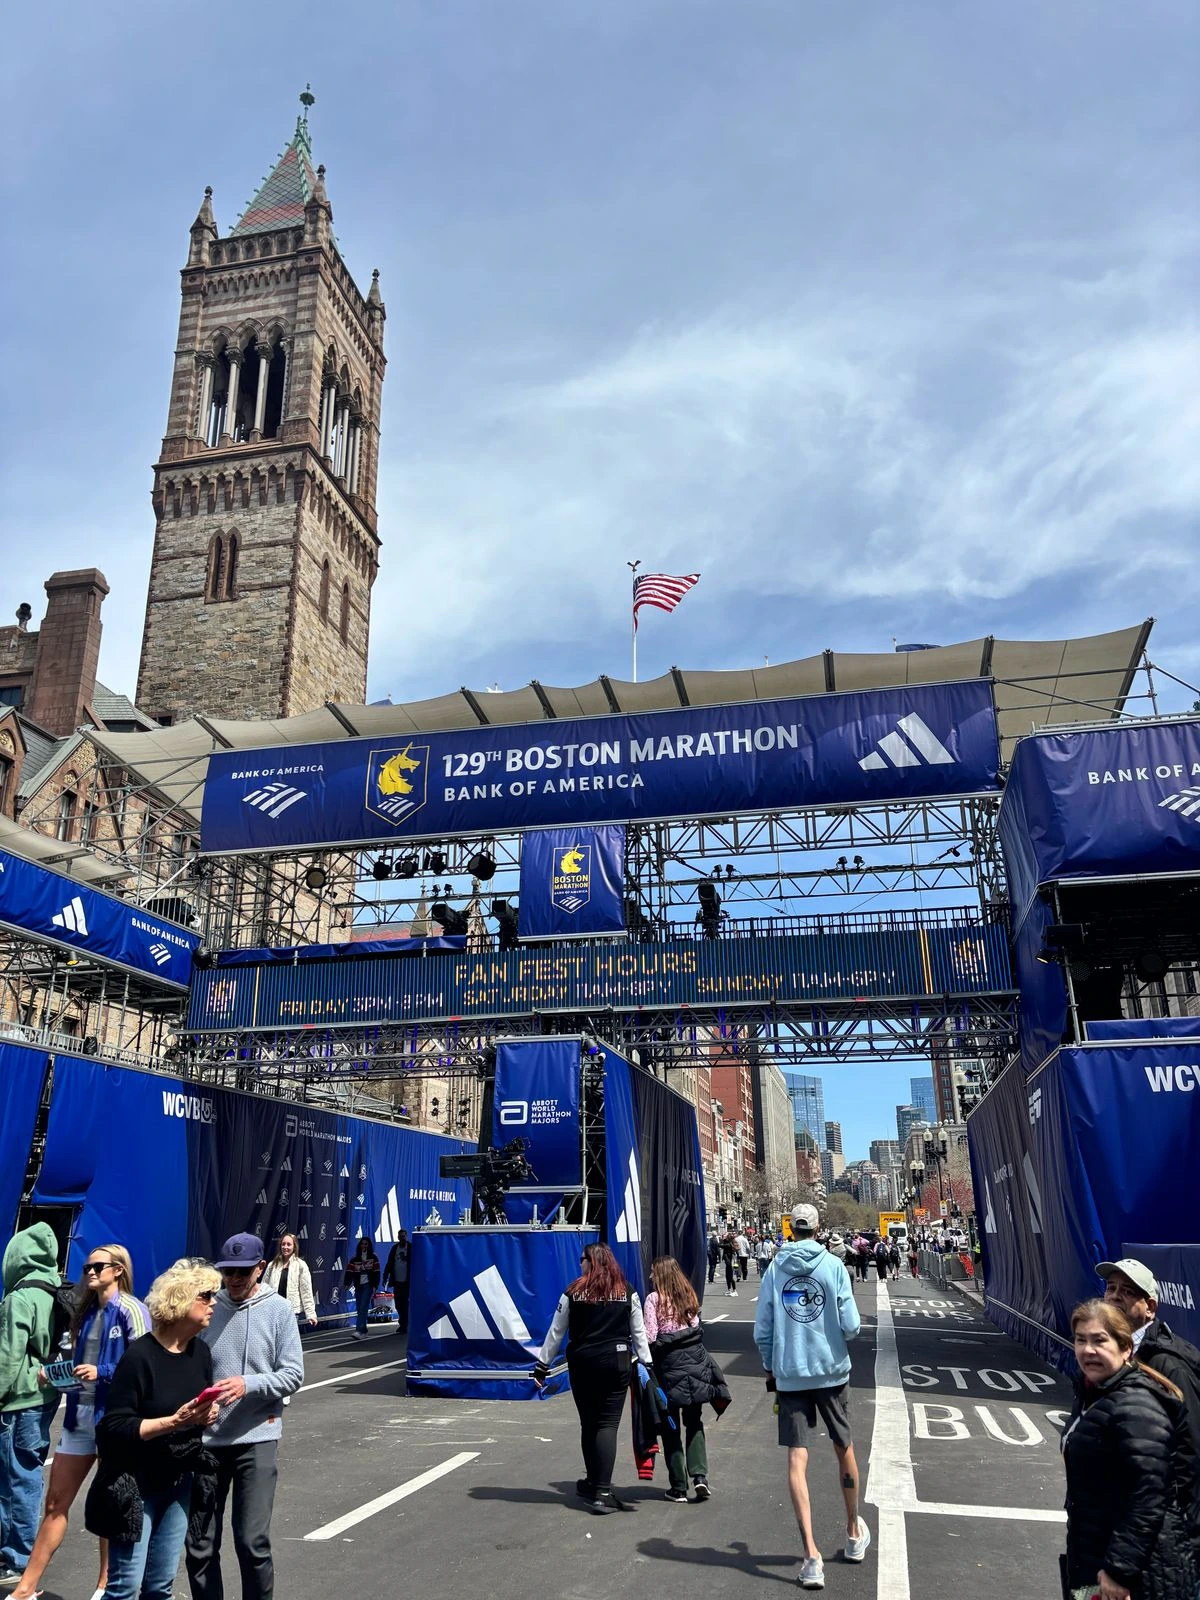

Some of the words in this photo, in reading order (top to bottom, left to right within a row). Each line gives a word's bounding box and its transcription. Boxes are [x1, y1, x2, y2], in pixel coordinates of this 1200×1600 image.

[442, 750, 502, 778] 129TH
[505, 740, 620, 772] BOSTON
[630, 724, 798, 763] MARATHON
[231, 769, 260, 780] BANK
[261, 768, 276, 777] OF
[276, 764, 324, 776] AMERICA
[1087, 767, 1150, 785] BANK
[1155, 764, 1183, 779] OF
[444, 783, 503, 802] BANK
[509, 780, 537, 797] OF
[542, 773, 645, 794] AMERICA
[554, 874, 588, 884] BOSTON
[554, 882, 588, 890] MARATHON
[131, 917, 151, 933] BANK
[151, 927, 161, 937] OF
[161, 930, 190, 949] AMERICA
[455, 961, 507, 986] FAN
[519, 957, 586, 982] FEST
[596, 951, 696, 977] HOURS
[697, 973, 783, 993] SUNDAY
[463, 985, 568, 1006] SATURDAY
[280, 998, 349, 1016] FRIDAY
[162, 1091, 200, 1120] WCVB
[313, 1131, 336, 1141] MARATHON
[336, 1135, 352, 1144] MAJORS
[889, 1298, 965, 1309] STOP
[894, 1308, 975, 1321] BUS
[902, 1364, 1057, 1393] STOP
